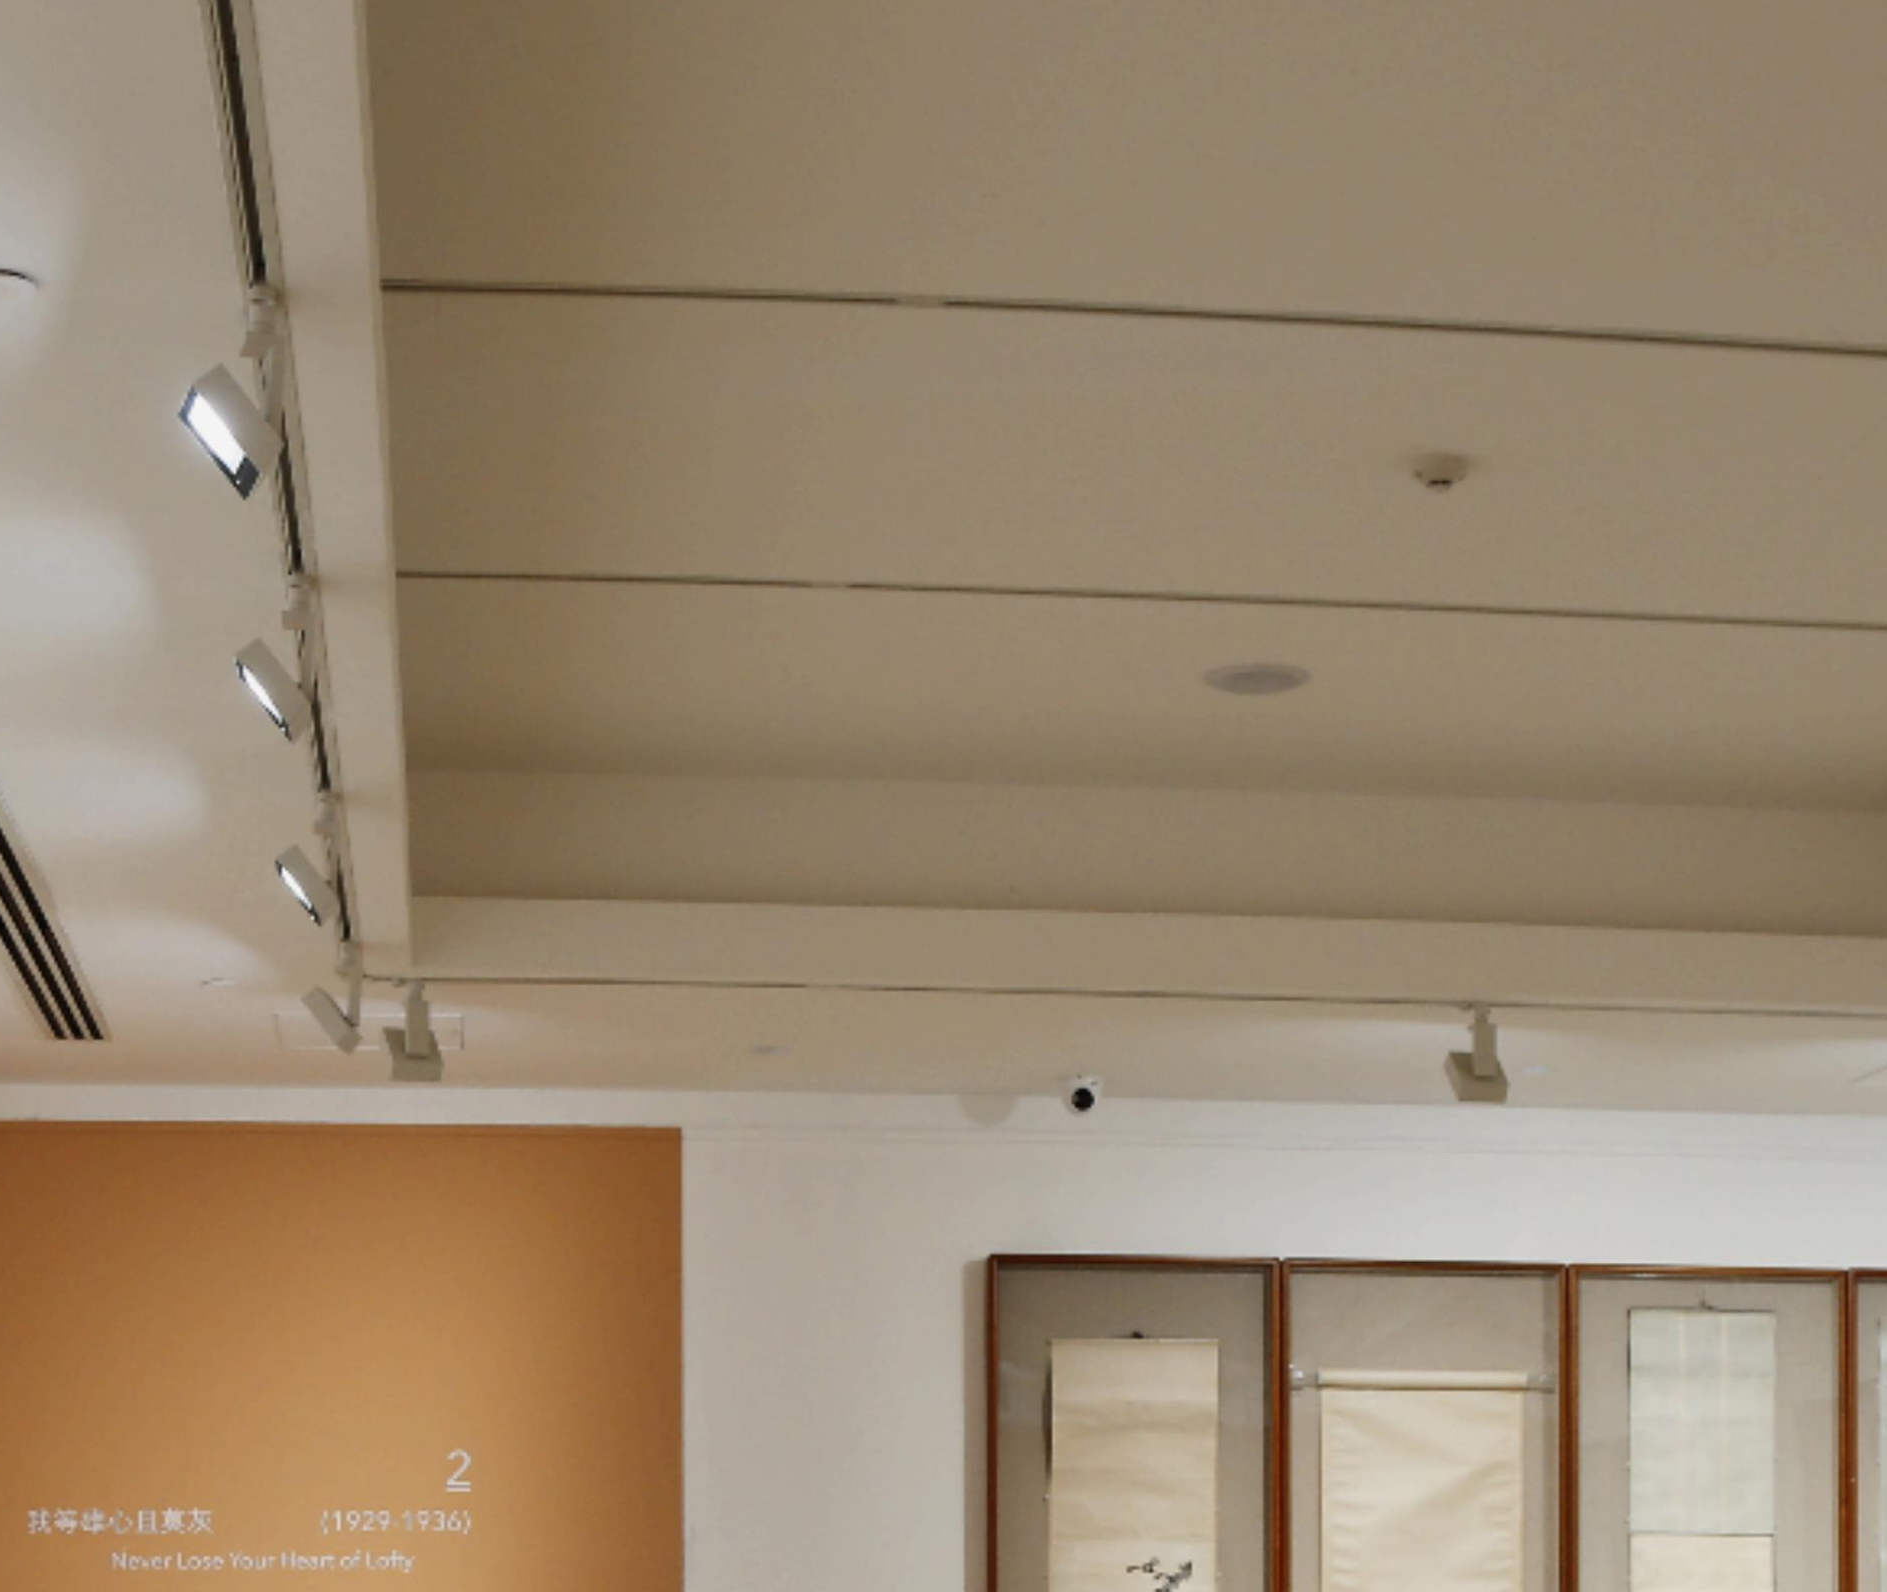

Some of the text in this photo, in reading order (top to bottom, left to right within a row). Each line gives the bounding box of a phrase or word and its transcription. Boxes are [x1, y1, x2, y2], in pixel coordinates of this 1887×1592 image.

[444, 1448, 472, 1488] 2
[319, 1509, 473, 1536] (1929-1936)
[111, 1550, 416, 1574] Never Lose Your Heart of Lofty
